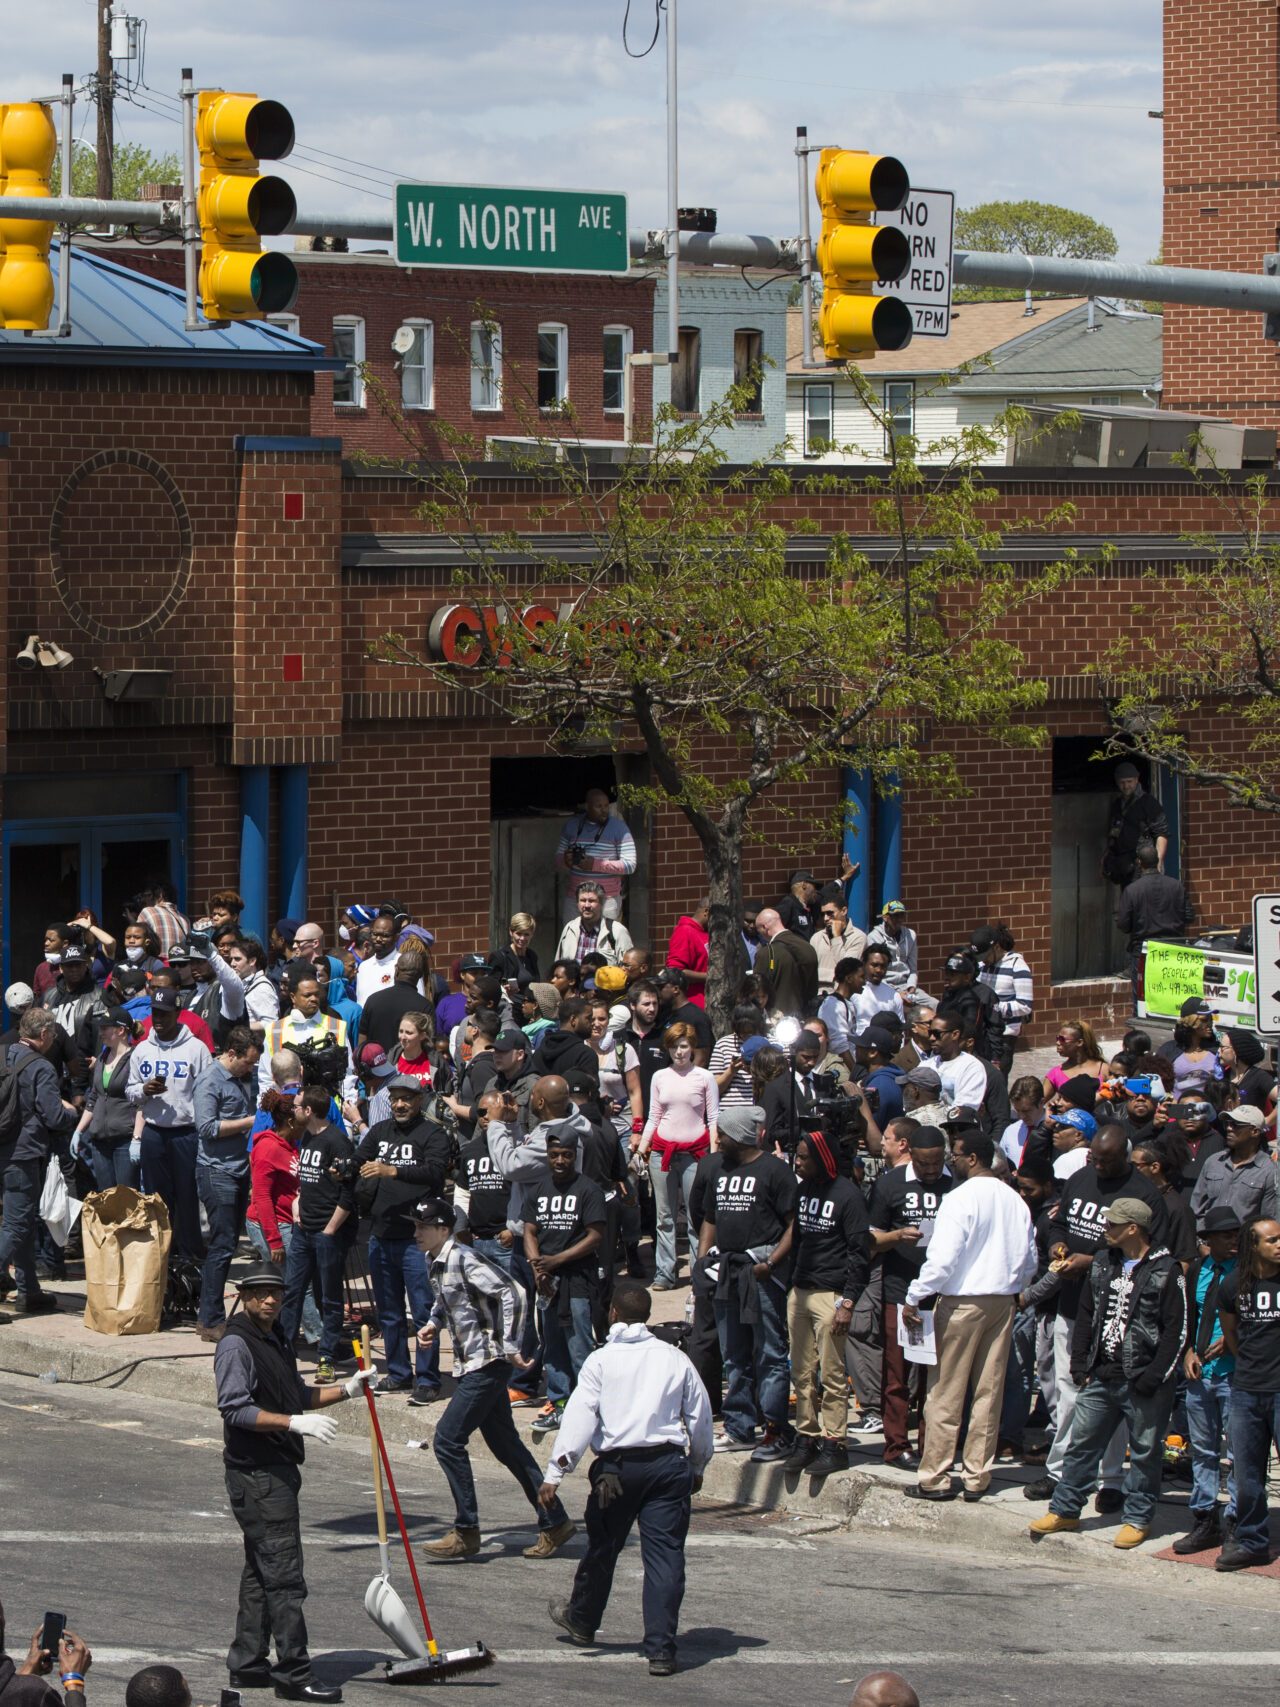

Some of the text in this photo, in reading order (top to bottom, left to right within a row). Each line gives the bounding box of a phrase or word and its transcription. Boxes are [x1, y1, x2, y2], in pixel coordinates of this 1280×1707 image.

[901, 202, 928, 227] NO
[406, 202, 612, 252] W. NORTH AVE
[911, 269, 945, 292] RED
[1150, 950, 1169, 962] THE
[716, 1176, 756, 1193] 300
[537, 1194, 577, 1213] 300
[728, 1194, 757, 1202] MARCH
[799, 1196, 835, 1218] 300
[905, 1192, 947, 1209] 30
[536, 1213, 579, 1222] MEN MARCH
[1069, 1198, 1108, 1224] 300
